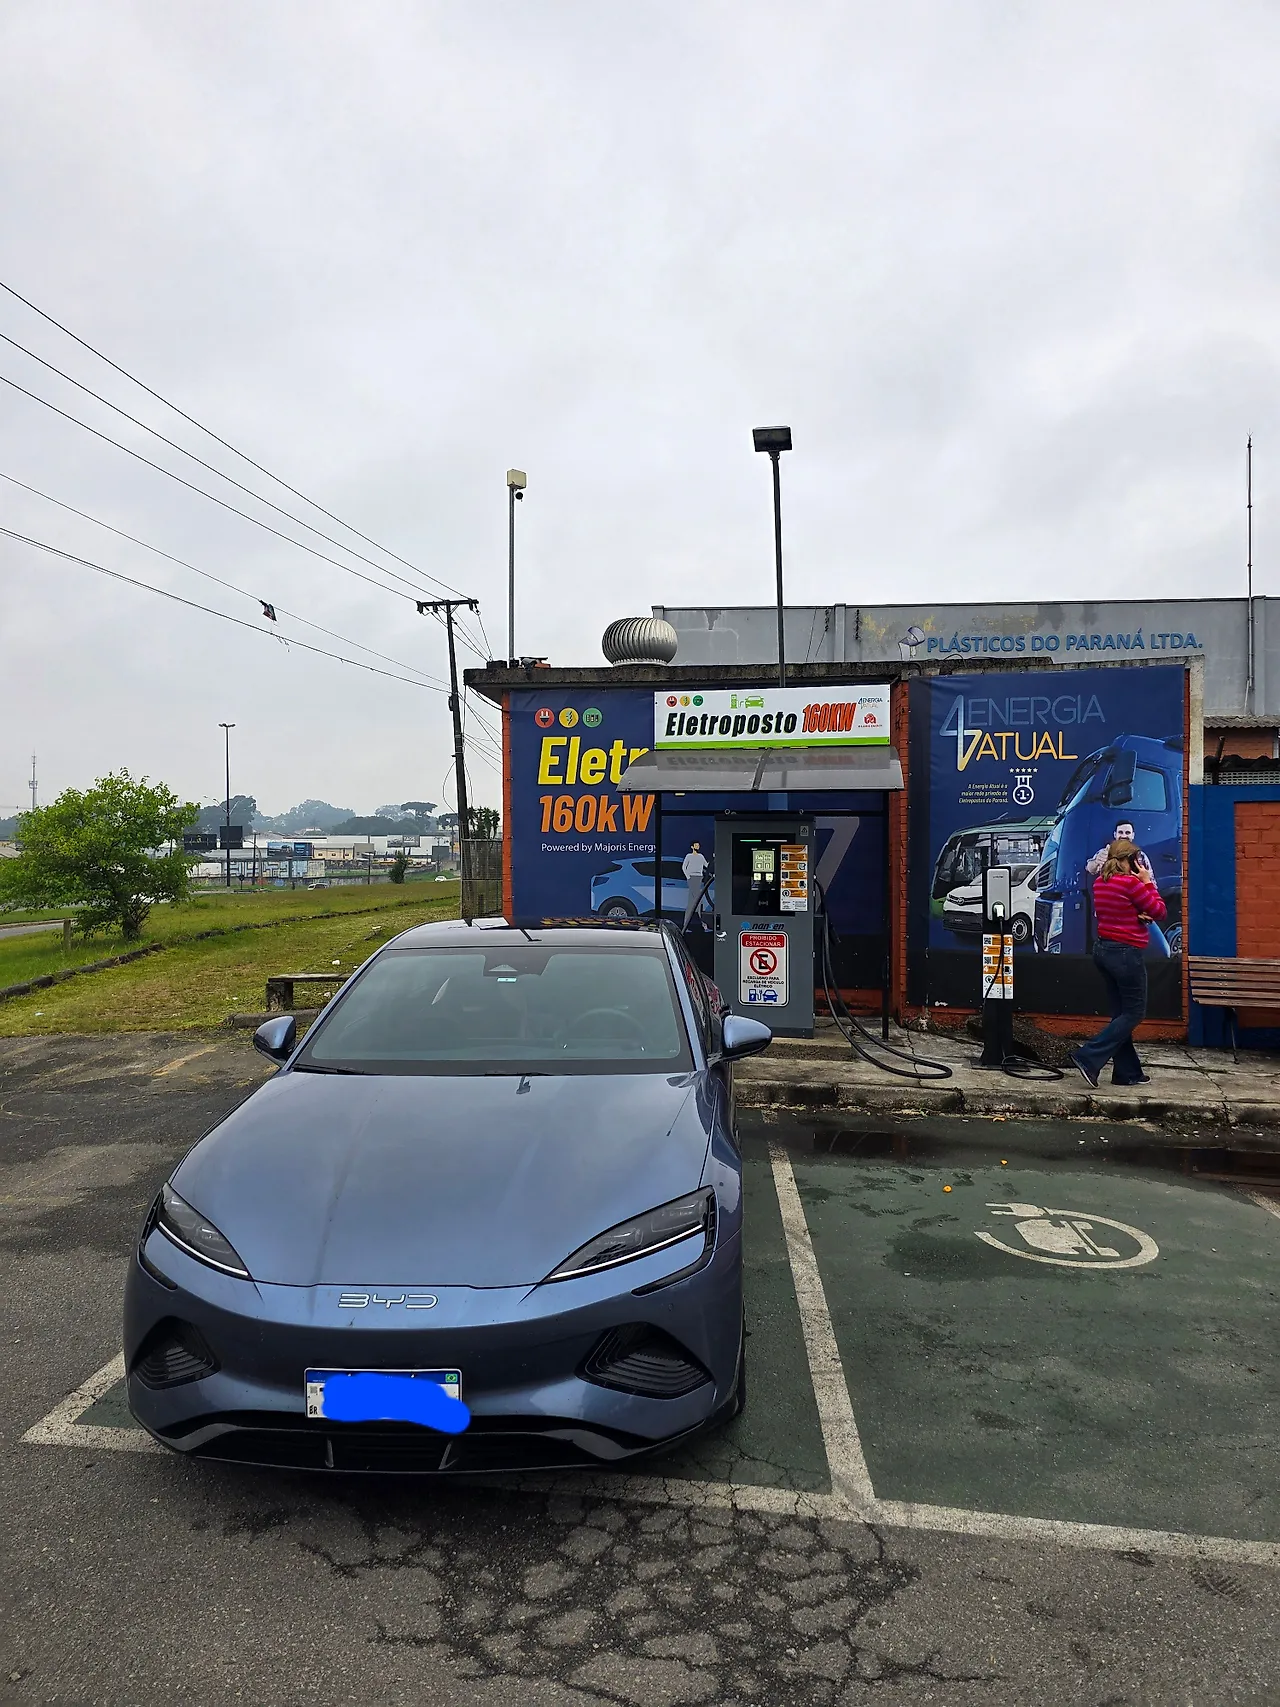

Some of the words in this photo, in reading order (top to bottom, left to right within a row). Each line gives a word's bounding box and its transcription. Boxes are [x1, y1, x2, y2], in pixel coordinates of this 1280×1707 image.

[927, 632, 1025, 653] PLÁSTICOS
[1031, 635, 1060, 651] DO
[1066, 628, 1145, 651] PARANÁ
[1150, 632, 1203, 650] LTDA.
[665, 711, 798, 738] Eletroposto
[801, 702, 857, 733] 160KW
[968, 694, 1106, 726] ENERGIA
[538, 736, 650, 785] Eletr
[976, 730, 1079, 761] ATUAL
[539, 794, 656, 833] 160kW
[541, 842, 580, 852] Powered
[581, 842, 593, 853] by
[594, 842, 627, 853] Majoris
[628, 842, 656, 853] Energy
[338, 1292, 439, 1309] BYD
